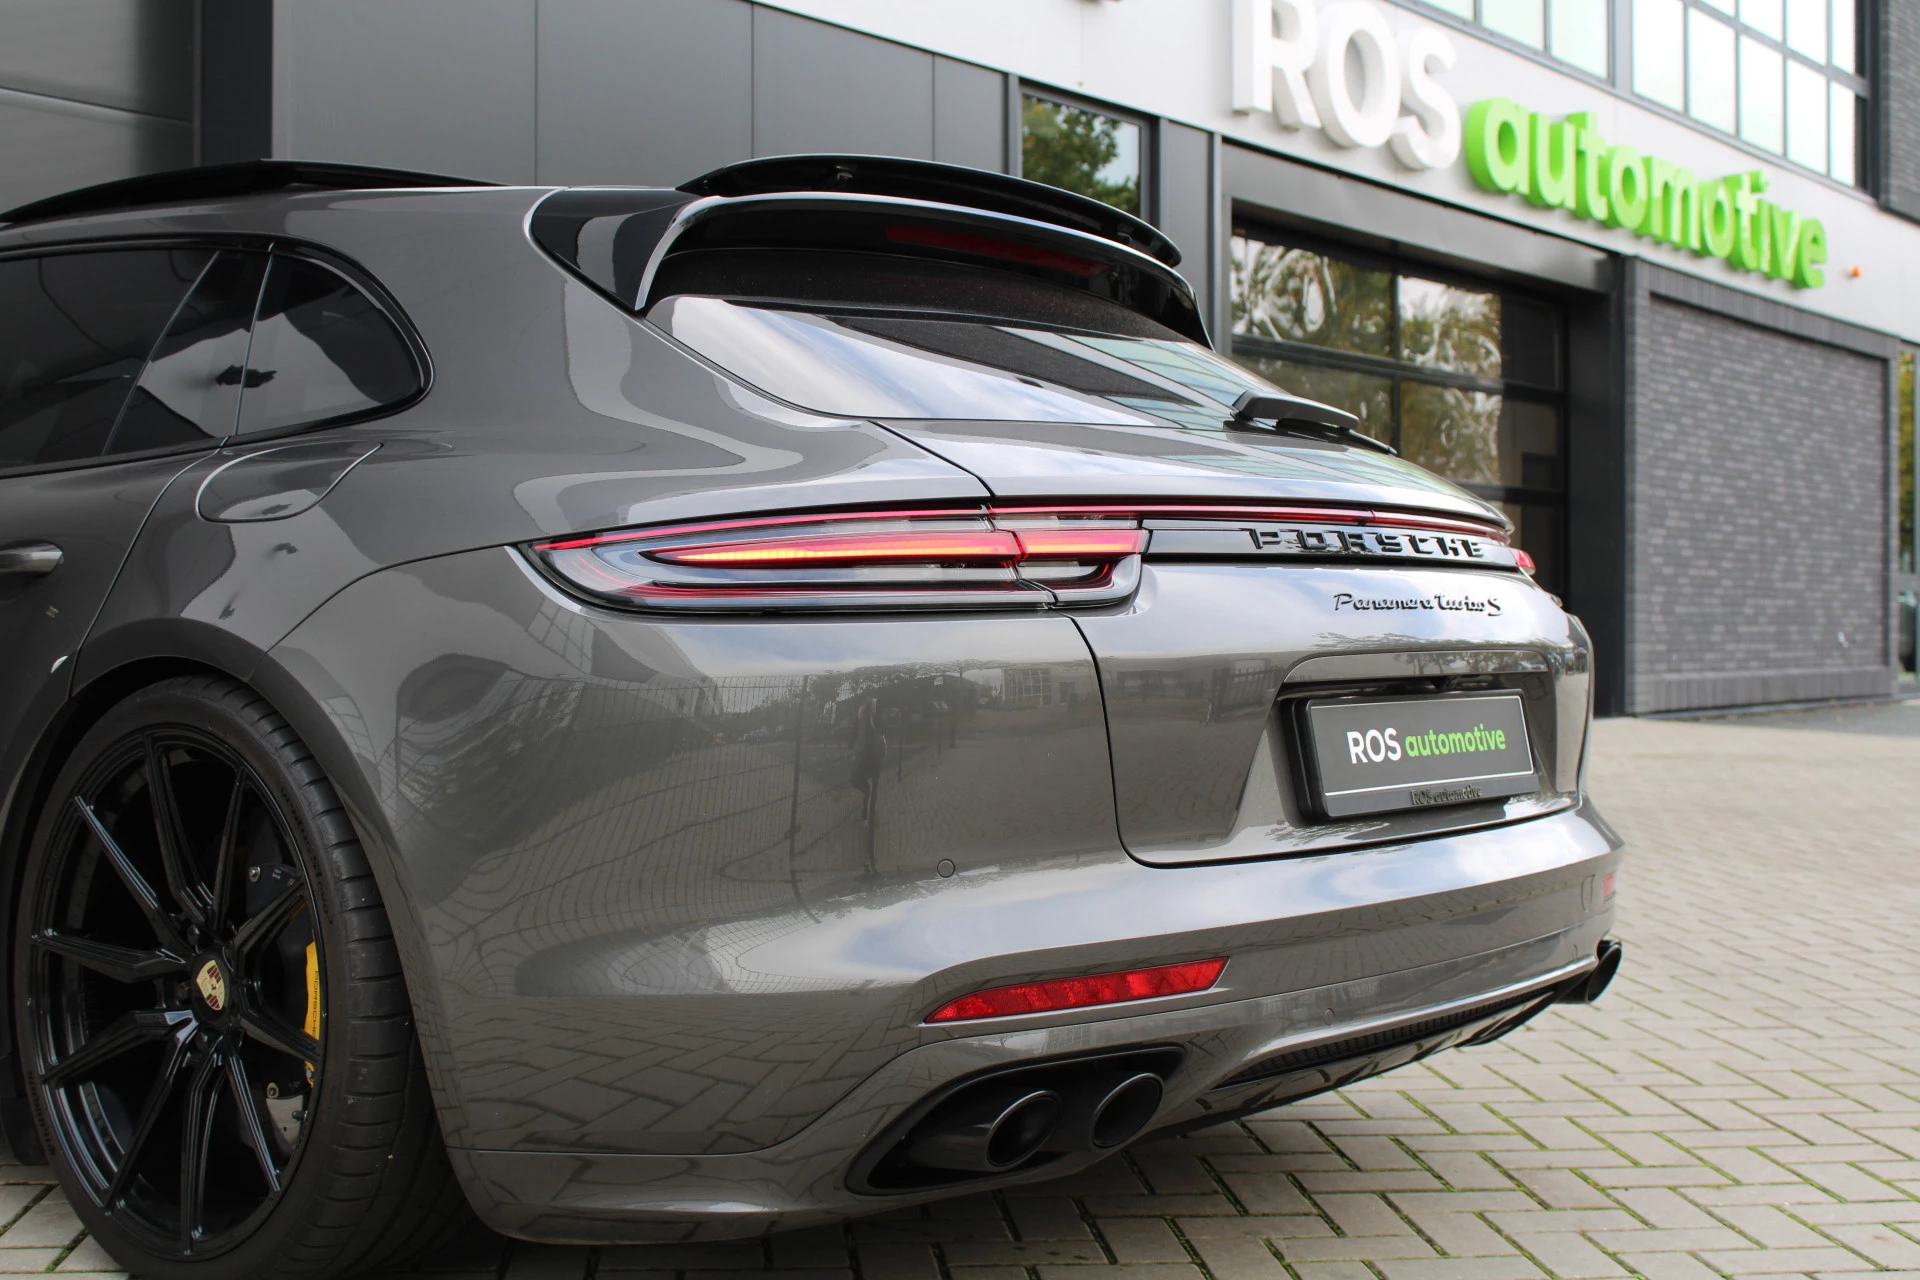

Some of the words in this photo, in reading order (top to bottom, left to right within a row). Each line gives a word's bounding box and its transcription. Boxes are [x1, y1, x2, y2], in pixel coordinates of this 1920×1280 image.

[1232, 0, 1461, 169] ROS
[1465, 98, 1827, 288] automotive
[1249, 527, 1485, 558] PORSCHE
[1333, 593, 1434, 611] Panamera
[1346, 727, 1402, 765] ROS
[1405, 723, 1506, 757] automotive
[1410, 789, 1433, 806] ROS
[1434, 784, 1483, 802] automotive
